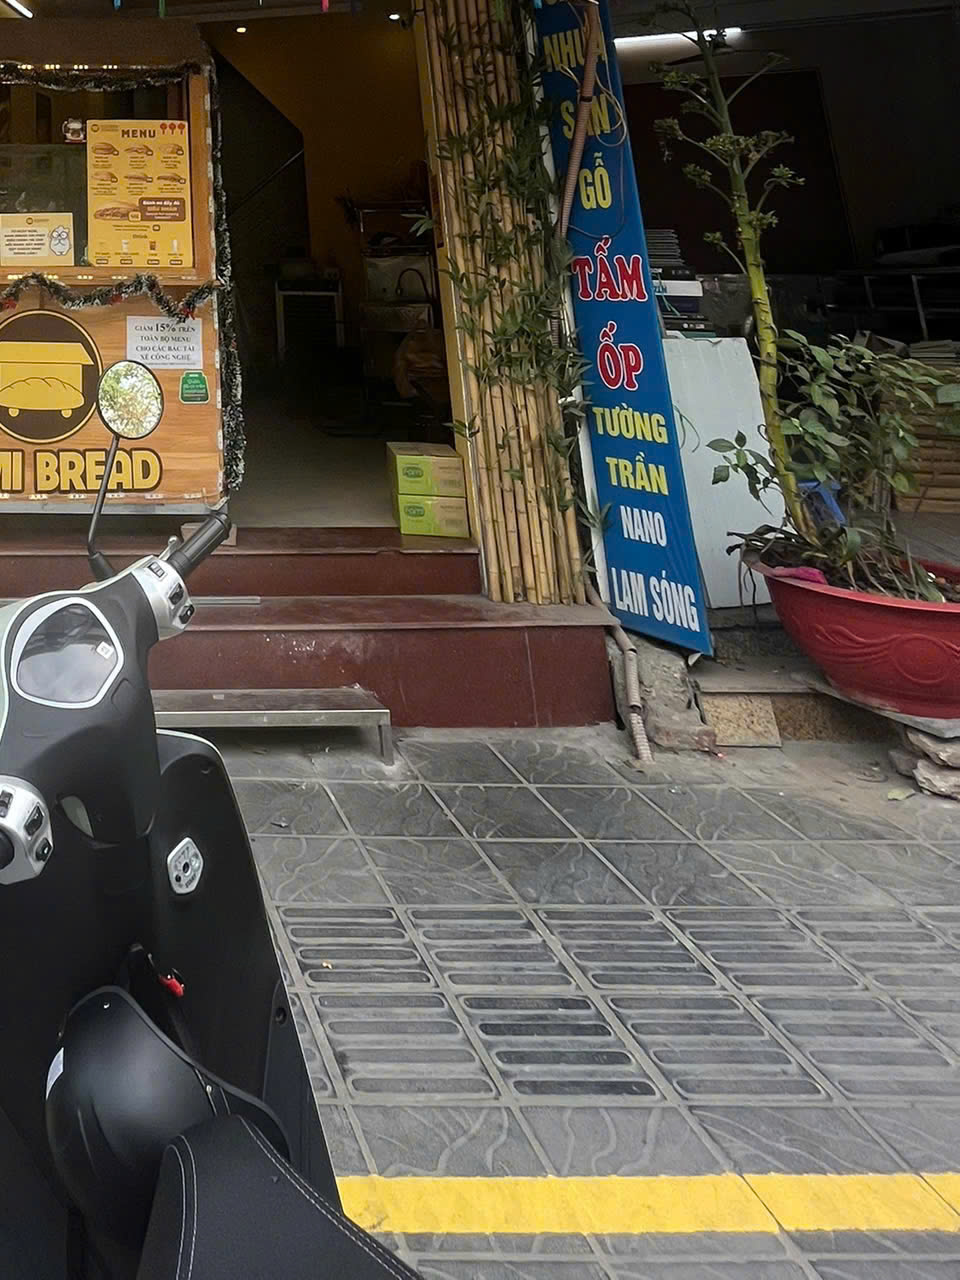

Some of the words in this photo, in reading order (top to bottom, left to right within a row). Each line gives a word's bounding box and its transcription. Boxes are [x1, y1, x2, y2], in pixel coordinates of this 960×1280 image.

[121, 129, 156, 138] MENU
[561, 94, 611, 139] SN
[579, 152, 612, 210] GỖ
[572, 234, 648, 302] TẤM
[155, 322, 176, 332] 15%
[597, 321, 643, 391] ỐP
[592, 406, 669, 445] TƯỜNG
[35, 449, 161, 493] BREAD
[606, 451, 669, 496] TRẦN
[620, 505, 667, 547] NANO
[612, 567, 648, 618] LAM
[650, 569, 701, 632] SÓNG
